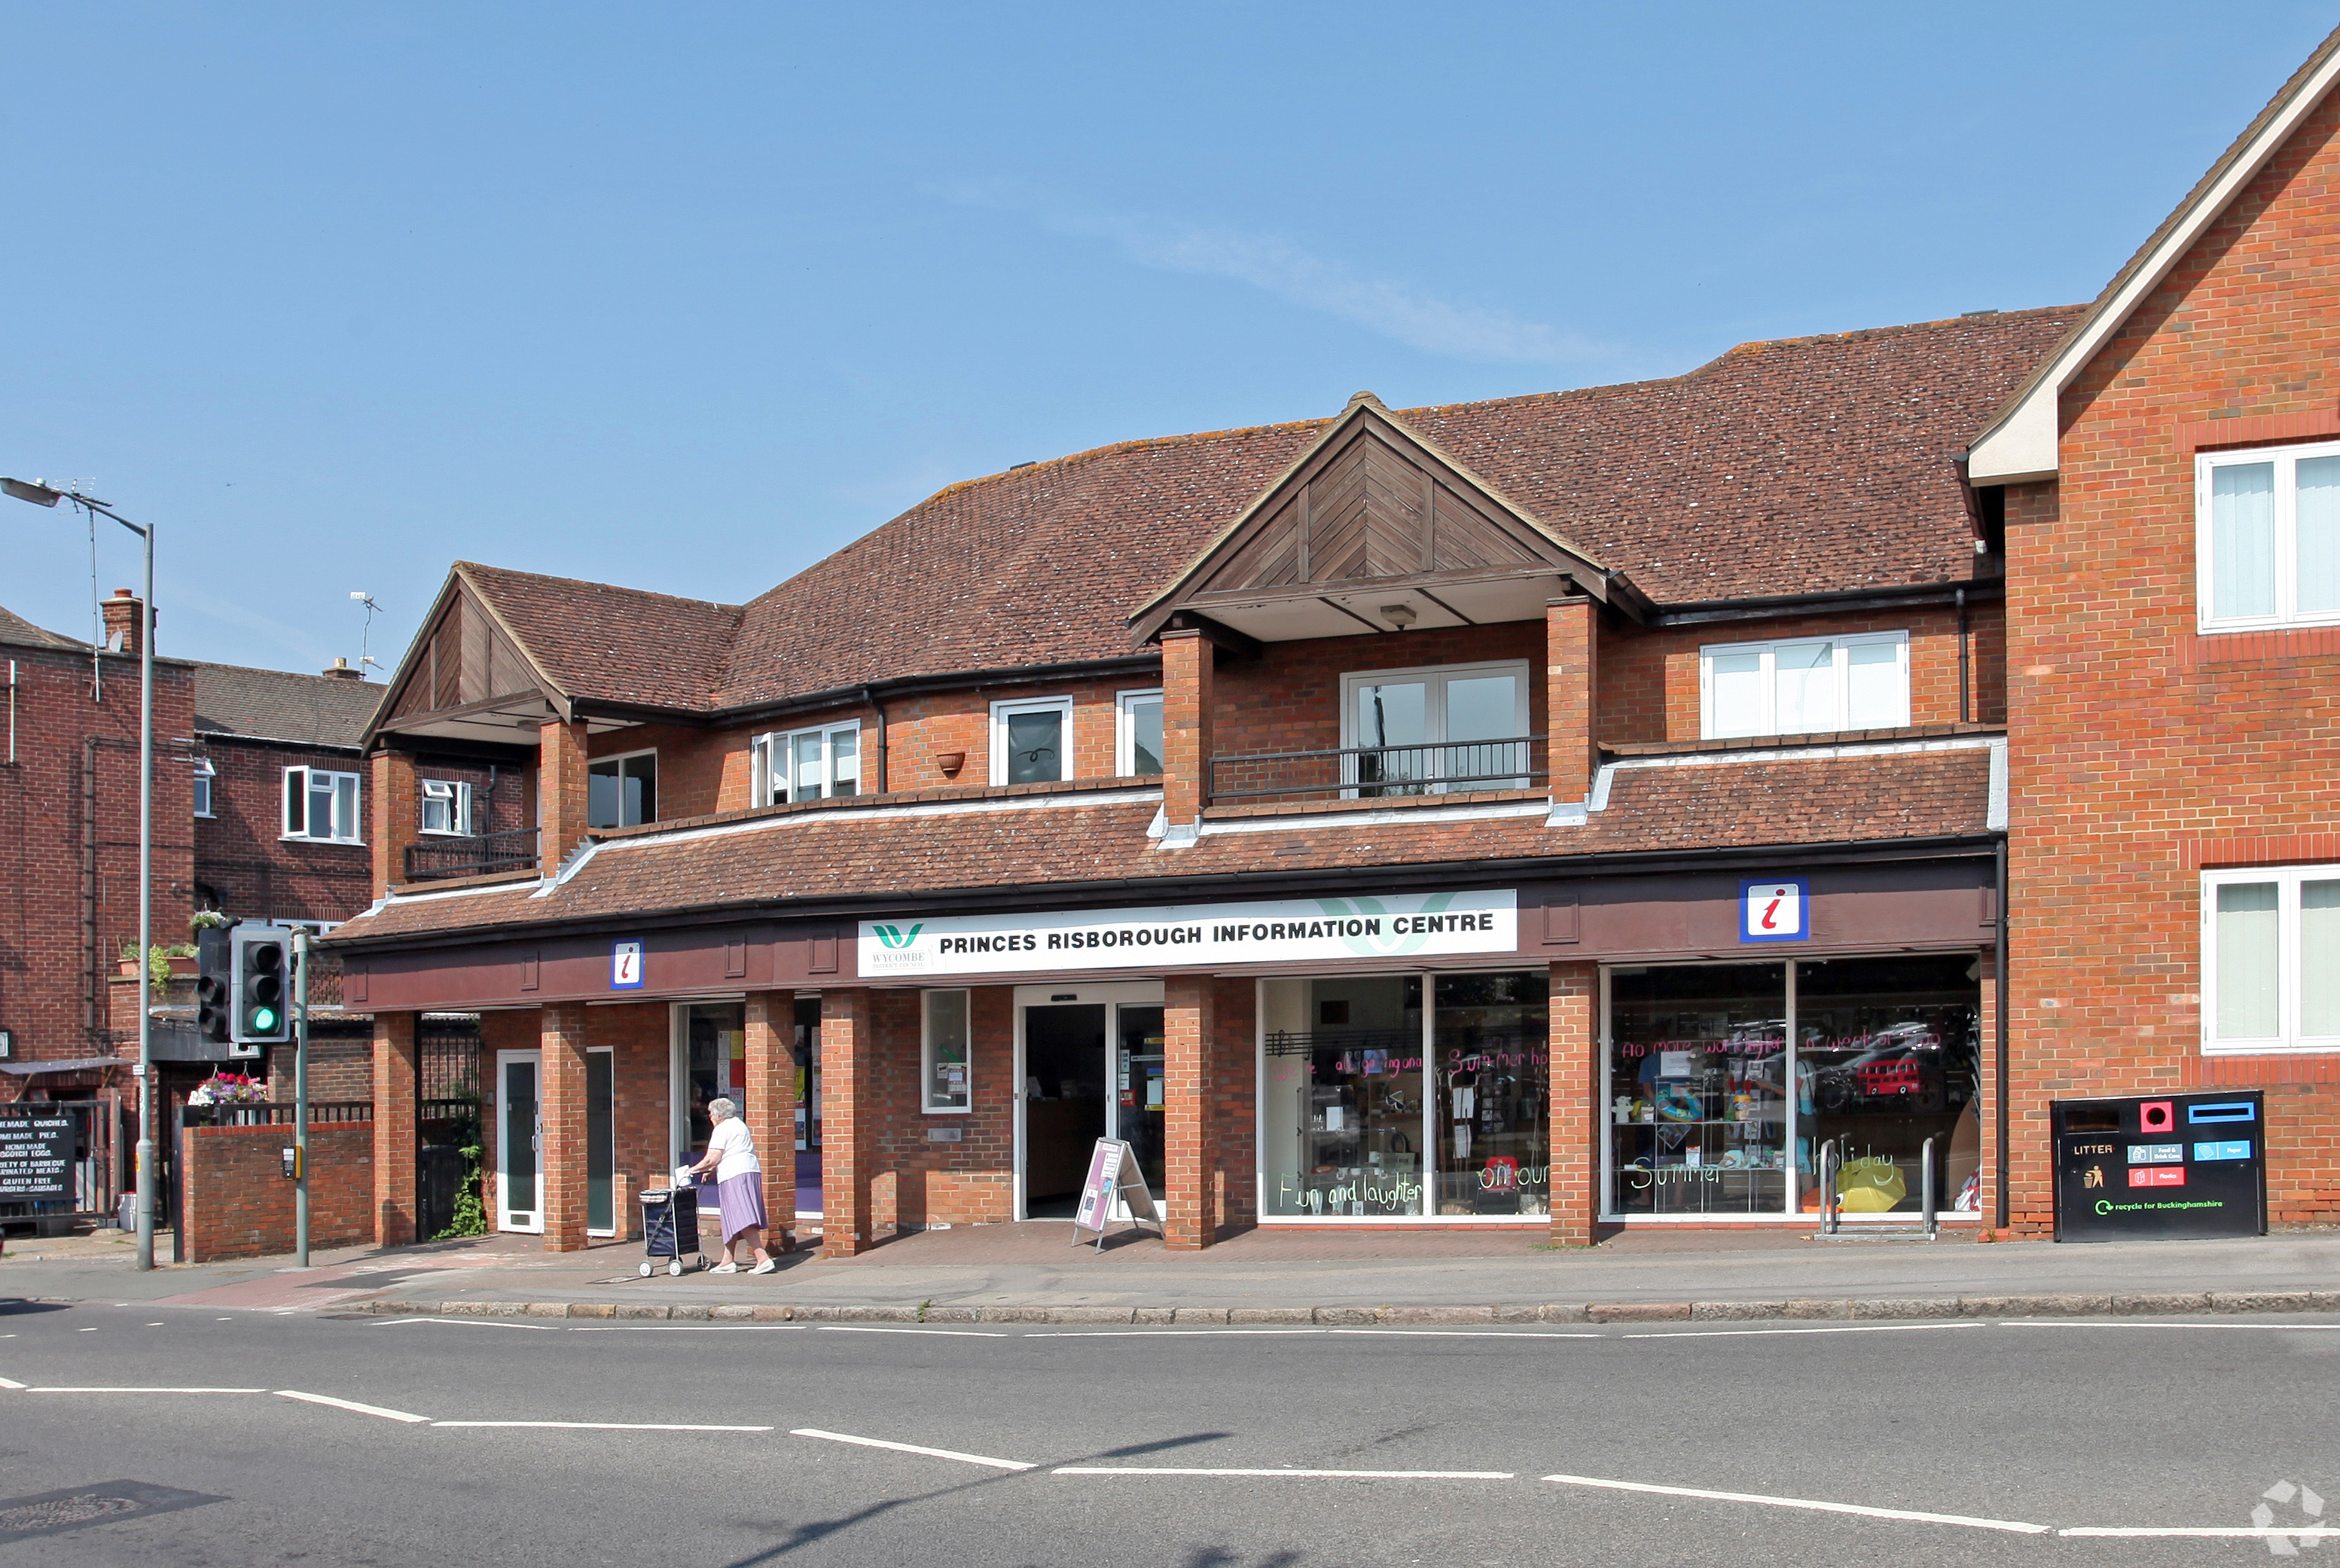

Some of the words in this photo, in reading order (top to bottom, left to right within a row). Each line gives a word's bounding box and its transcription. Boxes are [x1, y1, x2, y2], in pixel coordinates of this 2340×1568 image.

[940, 934, 1036, 954] PRINCES
[1048, 926, 1202, 950] RISBOROUGH
[1213, 918, 1381, 942] INFORMATION
[1393, 913, 1493, 935] CENTRE
[872, 952, 925, 963] WYCOMBE
[1335, 1054, 1355, 1072] all
[1448, 1048, 1525, 1074] Summer
[2073, 1145, 2113, 1155] LITTER
[1813, 1136, 1894, 1186] holiday
[3, 1177, 32, 1185] GLUTEN
[1517, 1165, 1550, 1185] our
[1280, 1172, 1319, 1208] Fun
[1328, 1179, 1357, 1204] and
[1363, 1171, 1423, 1211] laughter
[2115, 1203, 2143, 1211] recycle
[2144, 1202, 2155, 1210] for
[2156, 1200, 2224, 1210] Buckinghamshire
